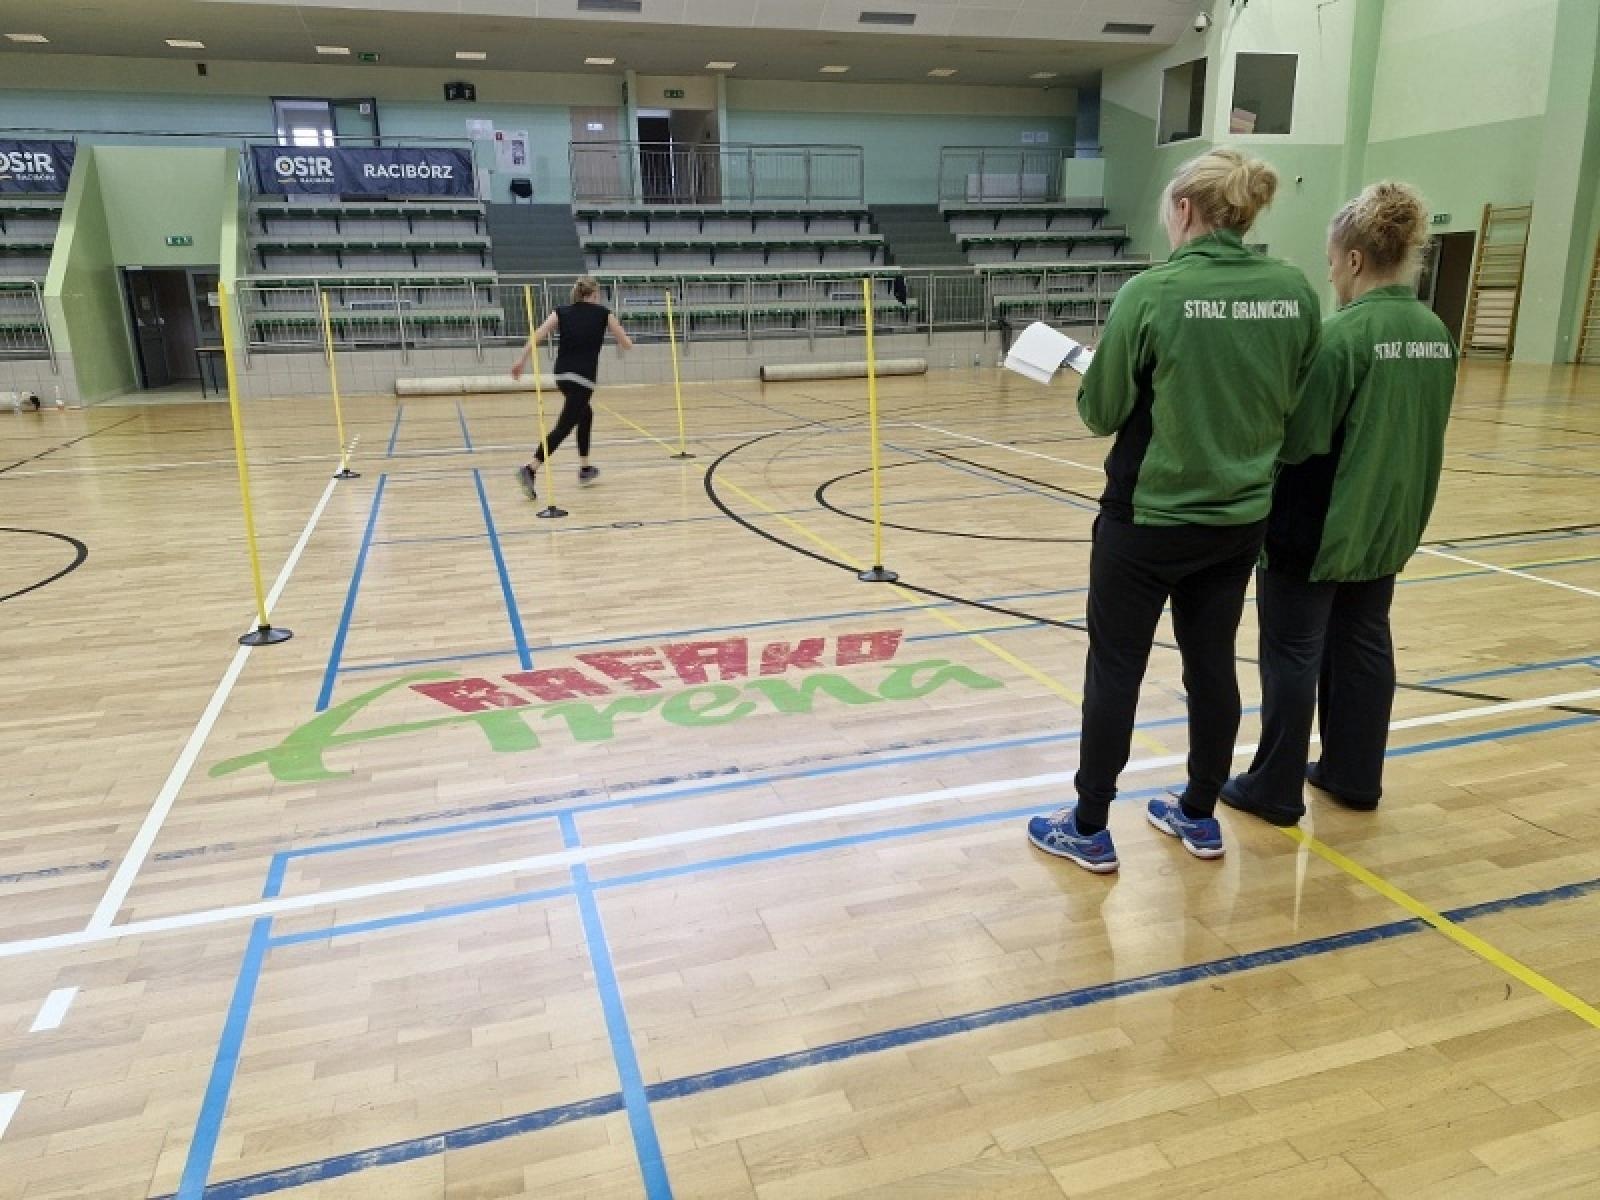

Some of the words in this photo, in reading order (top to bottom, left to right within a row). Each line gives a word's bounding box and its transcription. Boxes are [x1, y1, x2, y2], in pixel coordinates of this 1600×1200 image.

[363, 160, 453, 179] RACIBÓRZ
[409, 630, 903, 712] RAFAKO
[208, 659, 1005, 781] Arena
